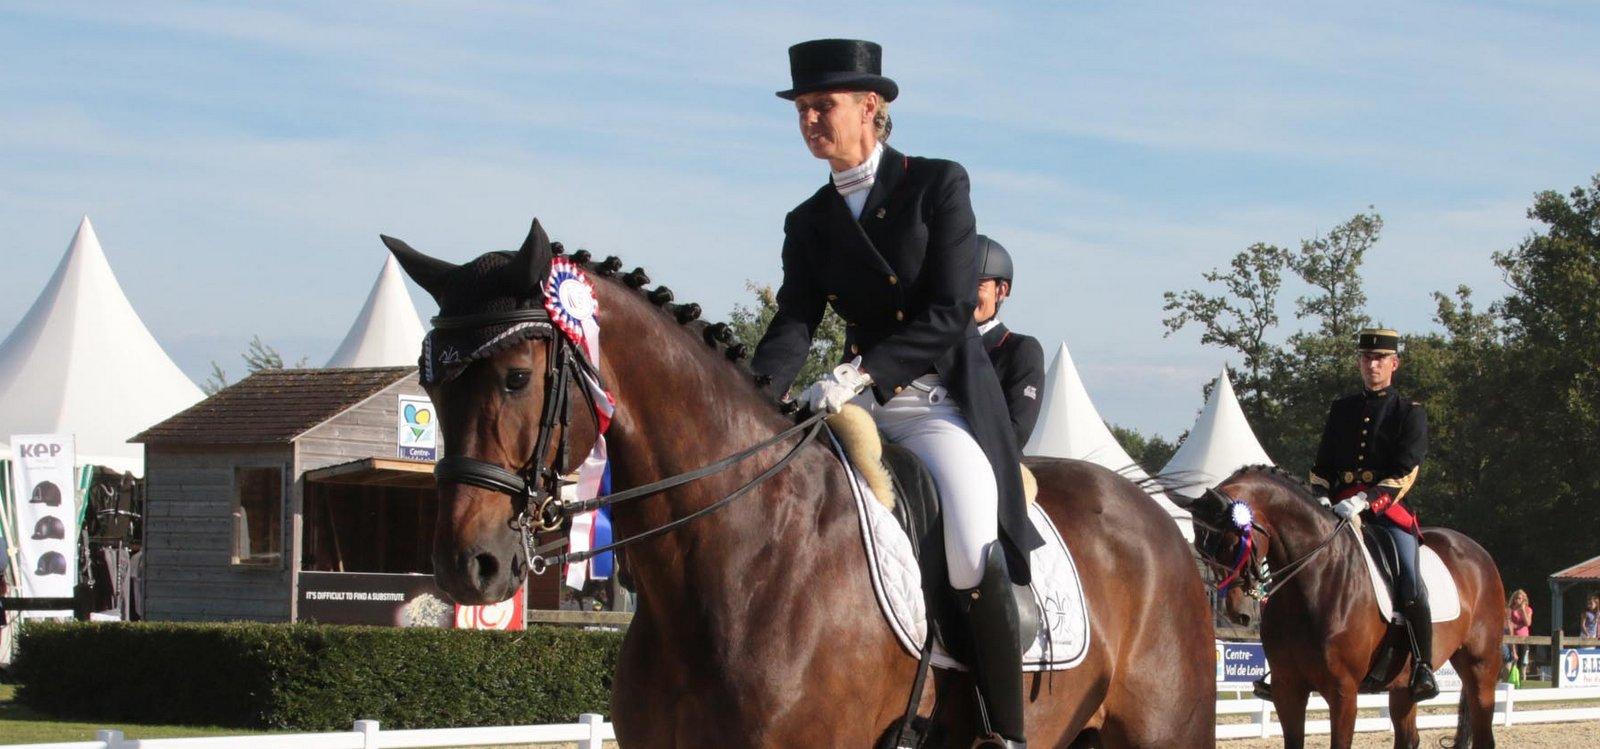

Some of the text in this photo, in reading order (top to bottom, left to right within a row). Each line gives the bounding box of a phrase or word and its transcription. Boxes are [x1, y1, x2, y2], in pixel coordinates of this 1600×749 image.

[409, 448, 430, 456] Centre-
[306, 591, 404, 601] IT'S DIFFICULT TO FIND A SUBSTITUTE
[1225, 649, 1253, 660] Centre-
[1225, 664, 1264, 676] Val de Loire
